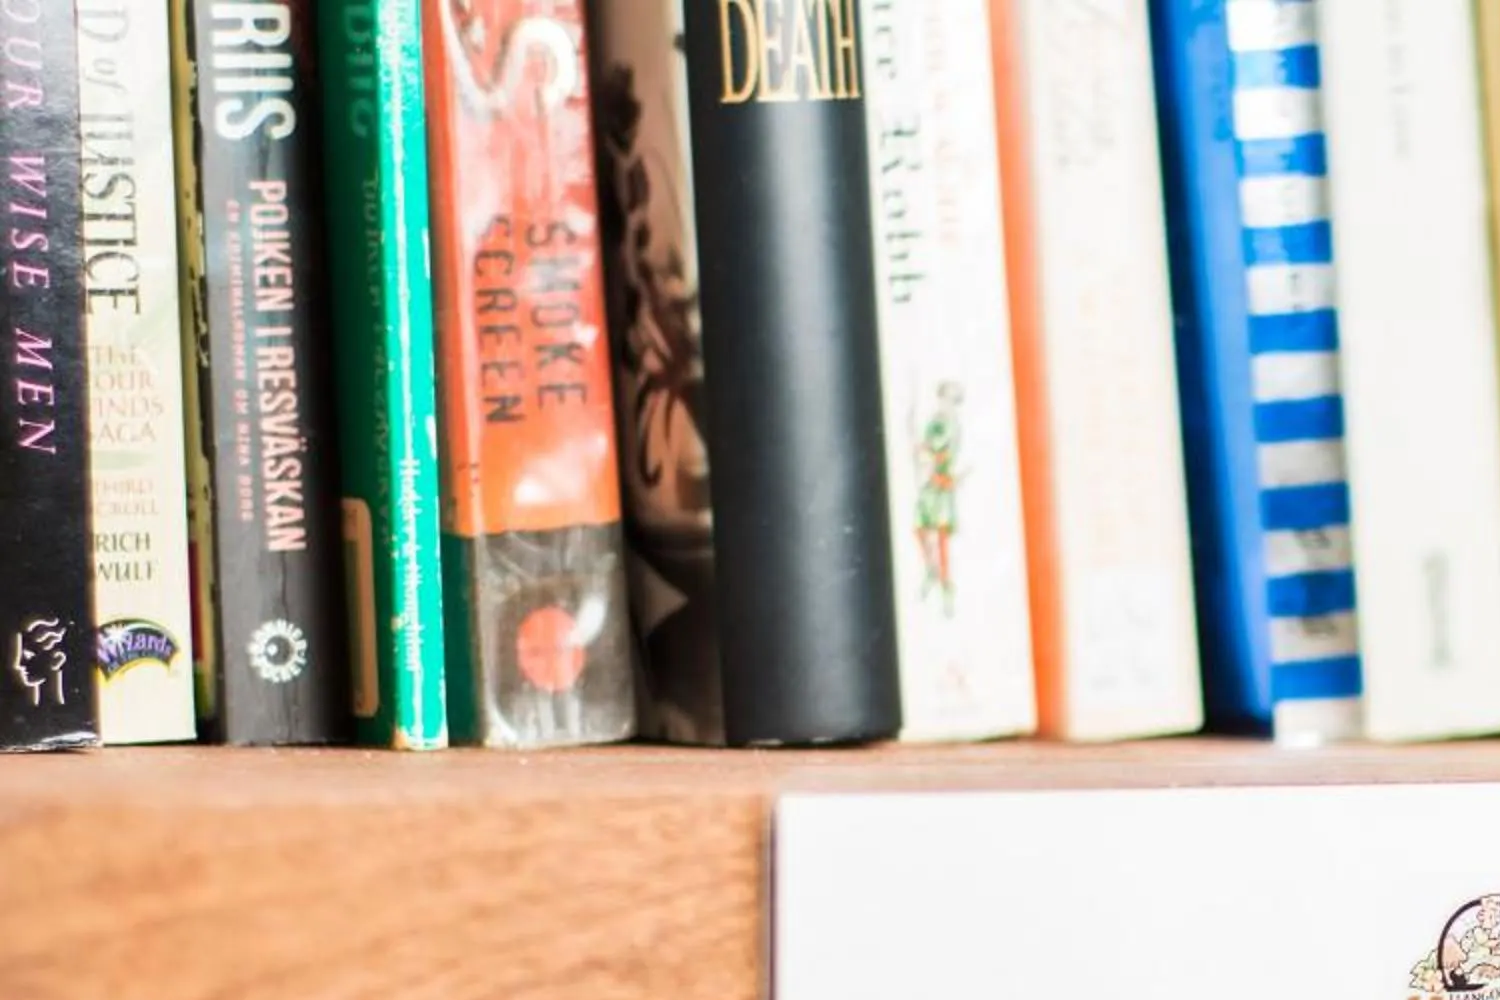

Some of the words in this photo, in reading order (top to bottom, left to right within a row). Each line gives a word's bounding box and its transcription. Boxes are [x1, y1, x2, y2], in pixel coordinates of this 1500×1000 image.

[86, 57, 126, 94] of
[211, 3, 297, 141] RIIS
[719, 0, 861, 103] DEATH
[8, 151, 51, 289] WISE
[80, 112, 141, 316] JUSTICE
[249, 180, 294, 312] POJKEN
[255, 326, 296, 338] I
[474, 214, 527, 427] SCREEN
[526, 220, 587, 410] SMOKE
[14, 328, 57, 455] MEN
[92, 422, 157, 443] AGA
[94, 396, 164, 417] INDS
[95, 370, 154, 391] OUR
[256, 346, 308, 552] RESVÄSKAN
[95, 532, 152, 552] RICH
